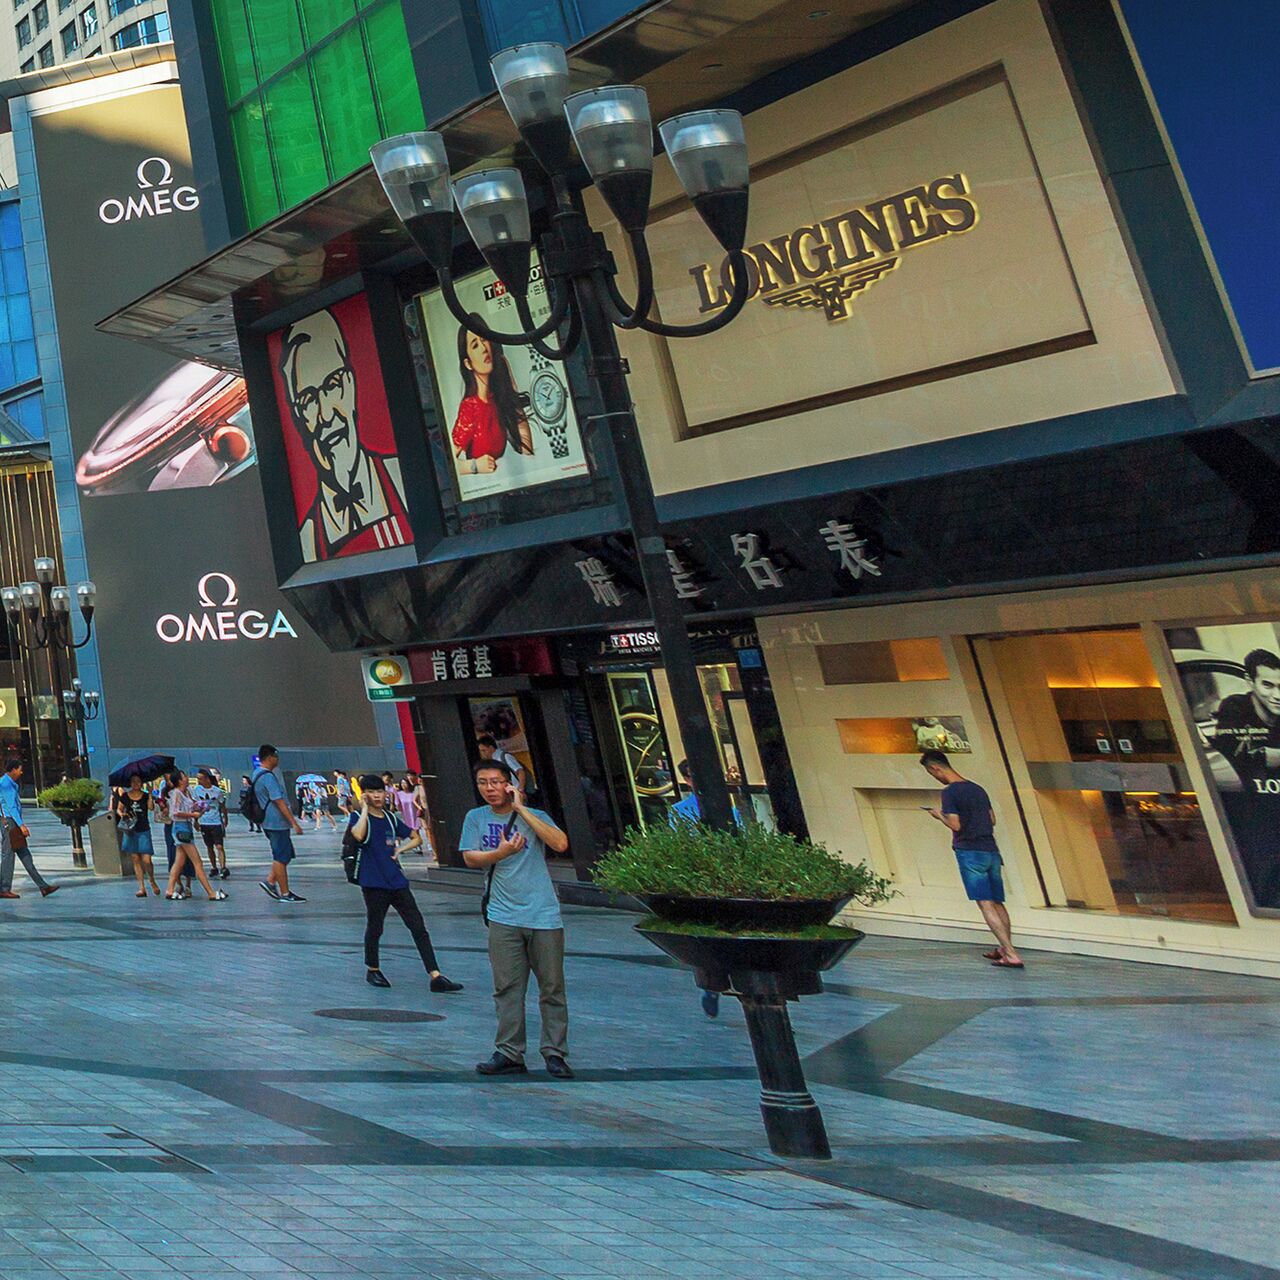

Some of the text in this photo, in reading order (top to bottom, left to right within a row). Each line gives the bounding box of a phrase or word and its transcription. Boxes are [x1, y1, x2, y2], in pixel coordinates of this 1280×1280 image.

[98, 185, 200, 224] OMEG
[688, 173, 978, 314] LONGINES
[155, 608, 298, 643] OMEGA
[431, 644, 493, 681] 肯德基
[1253, 778, 1280, 795] LO
